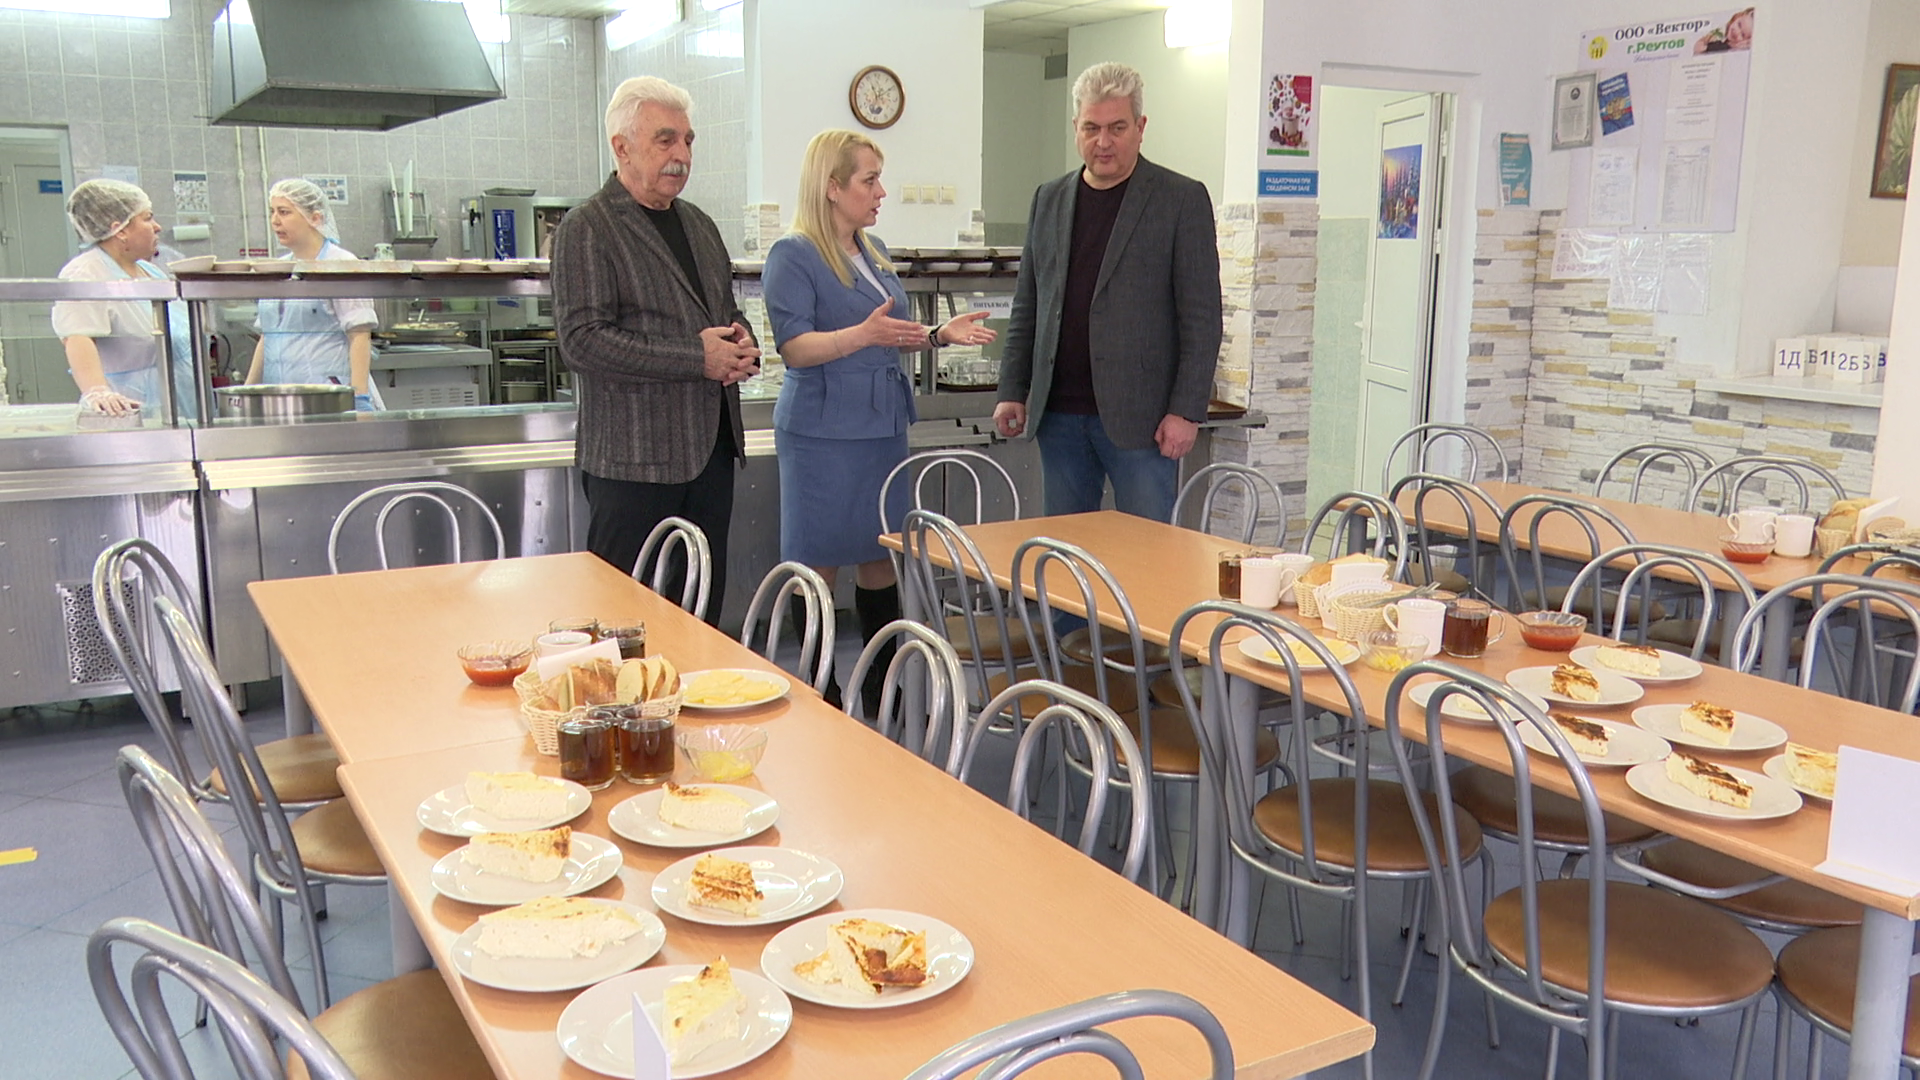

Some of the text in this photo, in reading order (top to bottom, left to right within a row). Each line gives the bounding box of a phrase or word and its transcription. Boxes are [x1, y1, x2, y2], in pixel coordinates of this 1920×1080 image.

[1615, 19, 1711, 41] ООО «Вектор»
[1626, 38, 1686, 54] г.Реутов
[1778, 348, 1801, 370] 1Д
[1838, 352, 1859, 371] 2Б
